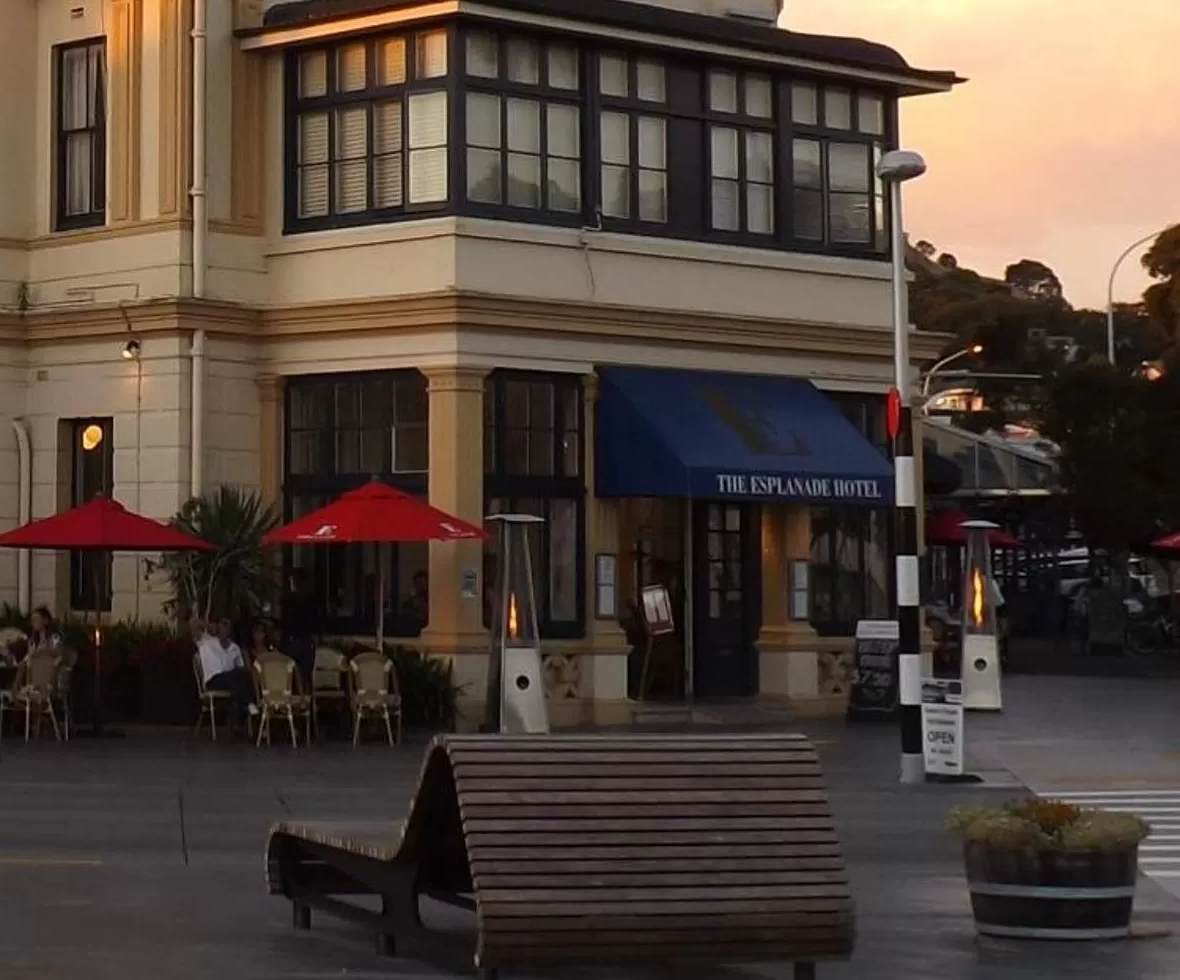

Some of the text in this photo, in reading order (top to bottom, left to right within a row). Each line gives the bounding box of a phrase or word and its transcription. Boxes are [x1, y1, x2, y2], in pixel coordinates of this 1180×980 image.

[717, 474, 882, 498] THE ESPLANADE HOTEL
[926, 730, 956, 745] OPEN
